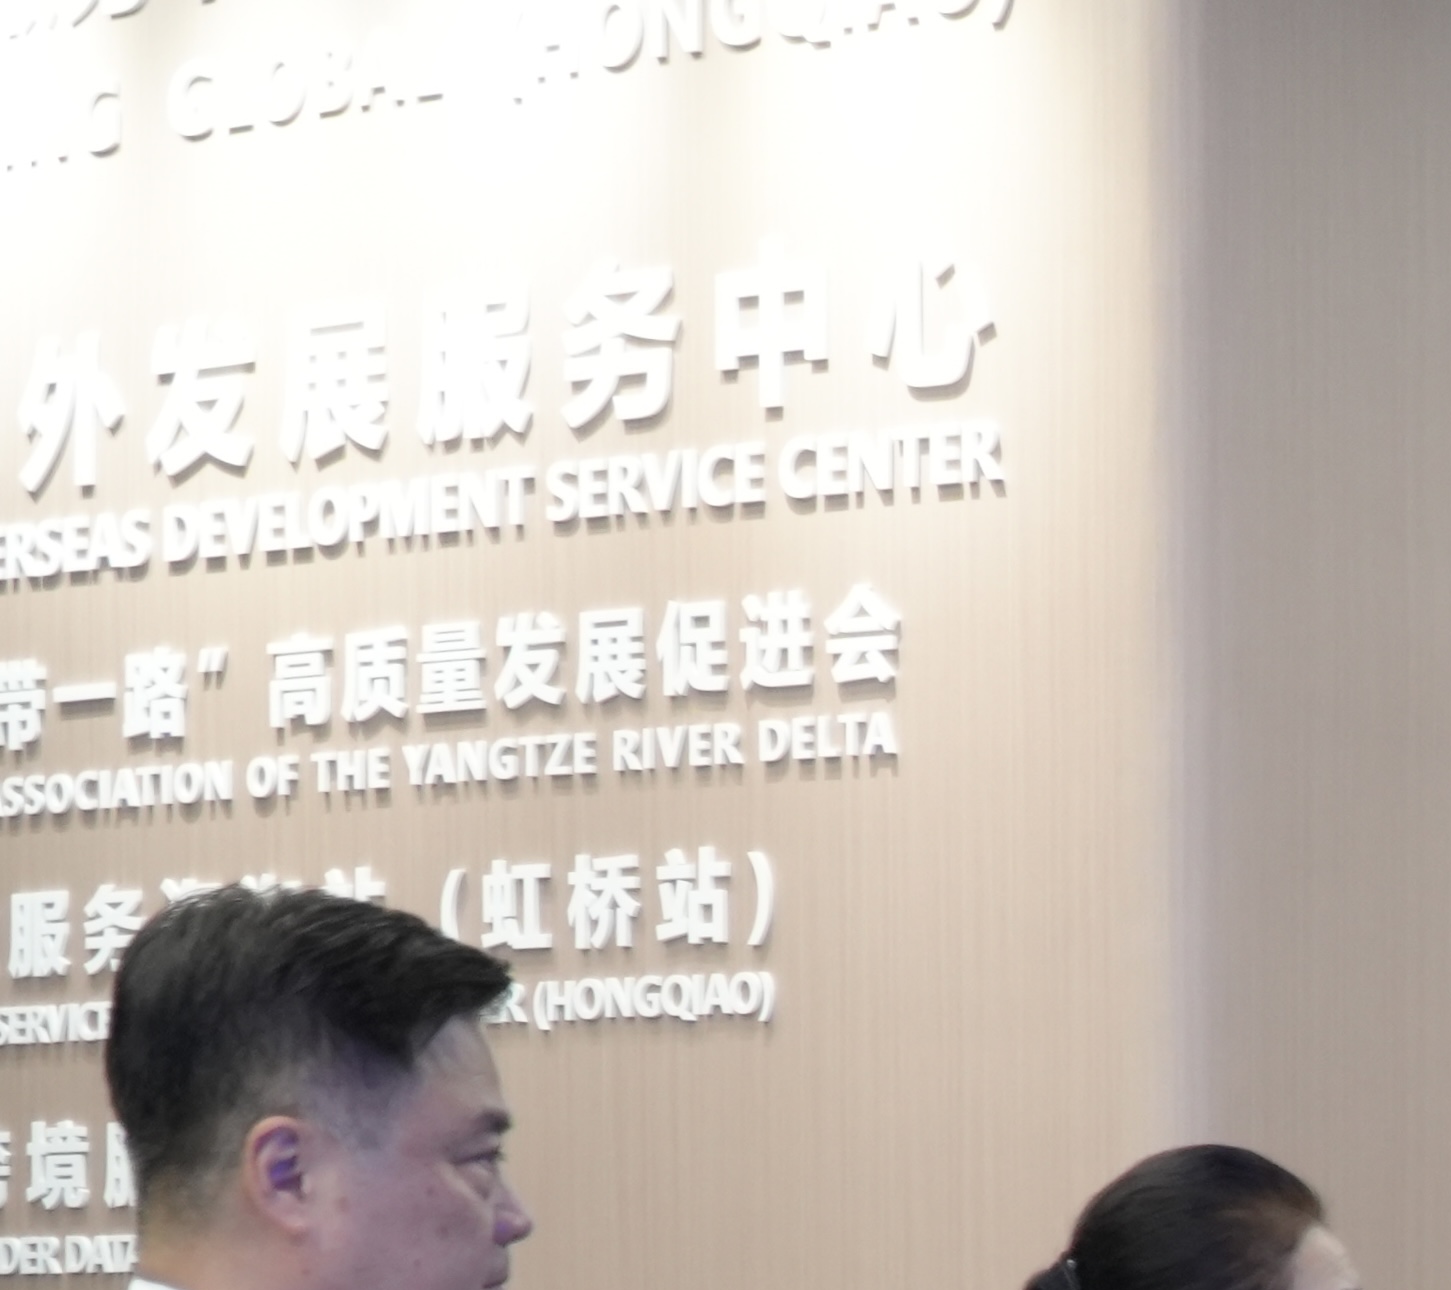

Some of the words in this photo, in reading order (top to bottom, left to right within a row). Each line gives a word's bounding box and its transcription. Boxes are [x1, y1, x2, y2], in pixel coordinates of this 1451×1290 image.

[18, 236, 996, 493] 外发展服务中心
[162, 465, 536, 563] DEVELOPMENT
[546, 441, 764, 522] SERVICE
[779, 418, 1004, 500] CENTER
[0, 761, 233, 817] SSOCIATION
[246, 755, 300, 799] OF
[310, 747, 391, 793] THE
[402, 732, 597, 786] YANGTZE
[612, 720, 744, 772] RIVER
[757, 712, 898, 760] DELTA
[533, 971, 775, 1030] (HONGQIAO)
